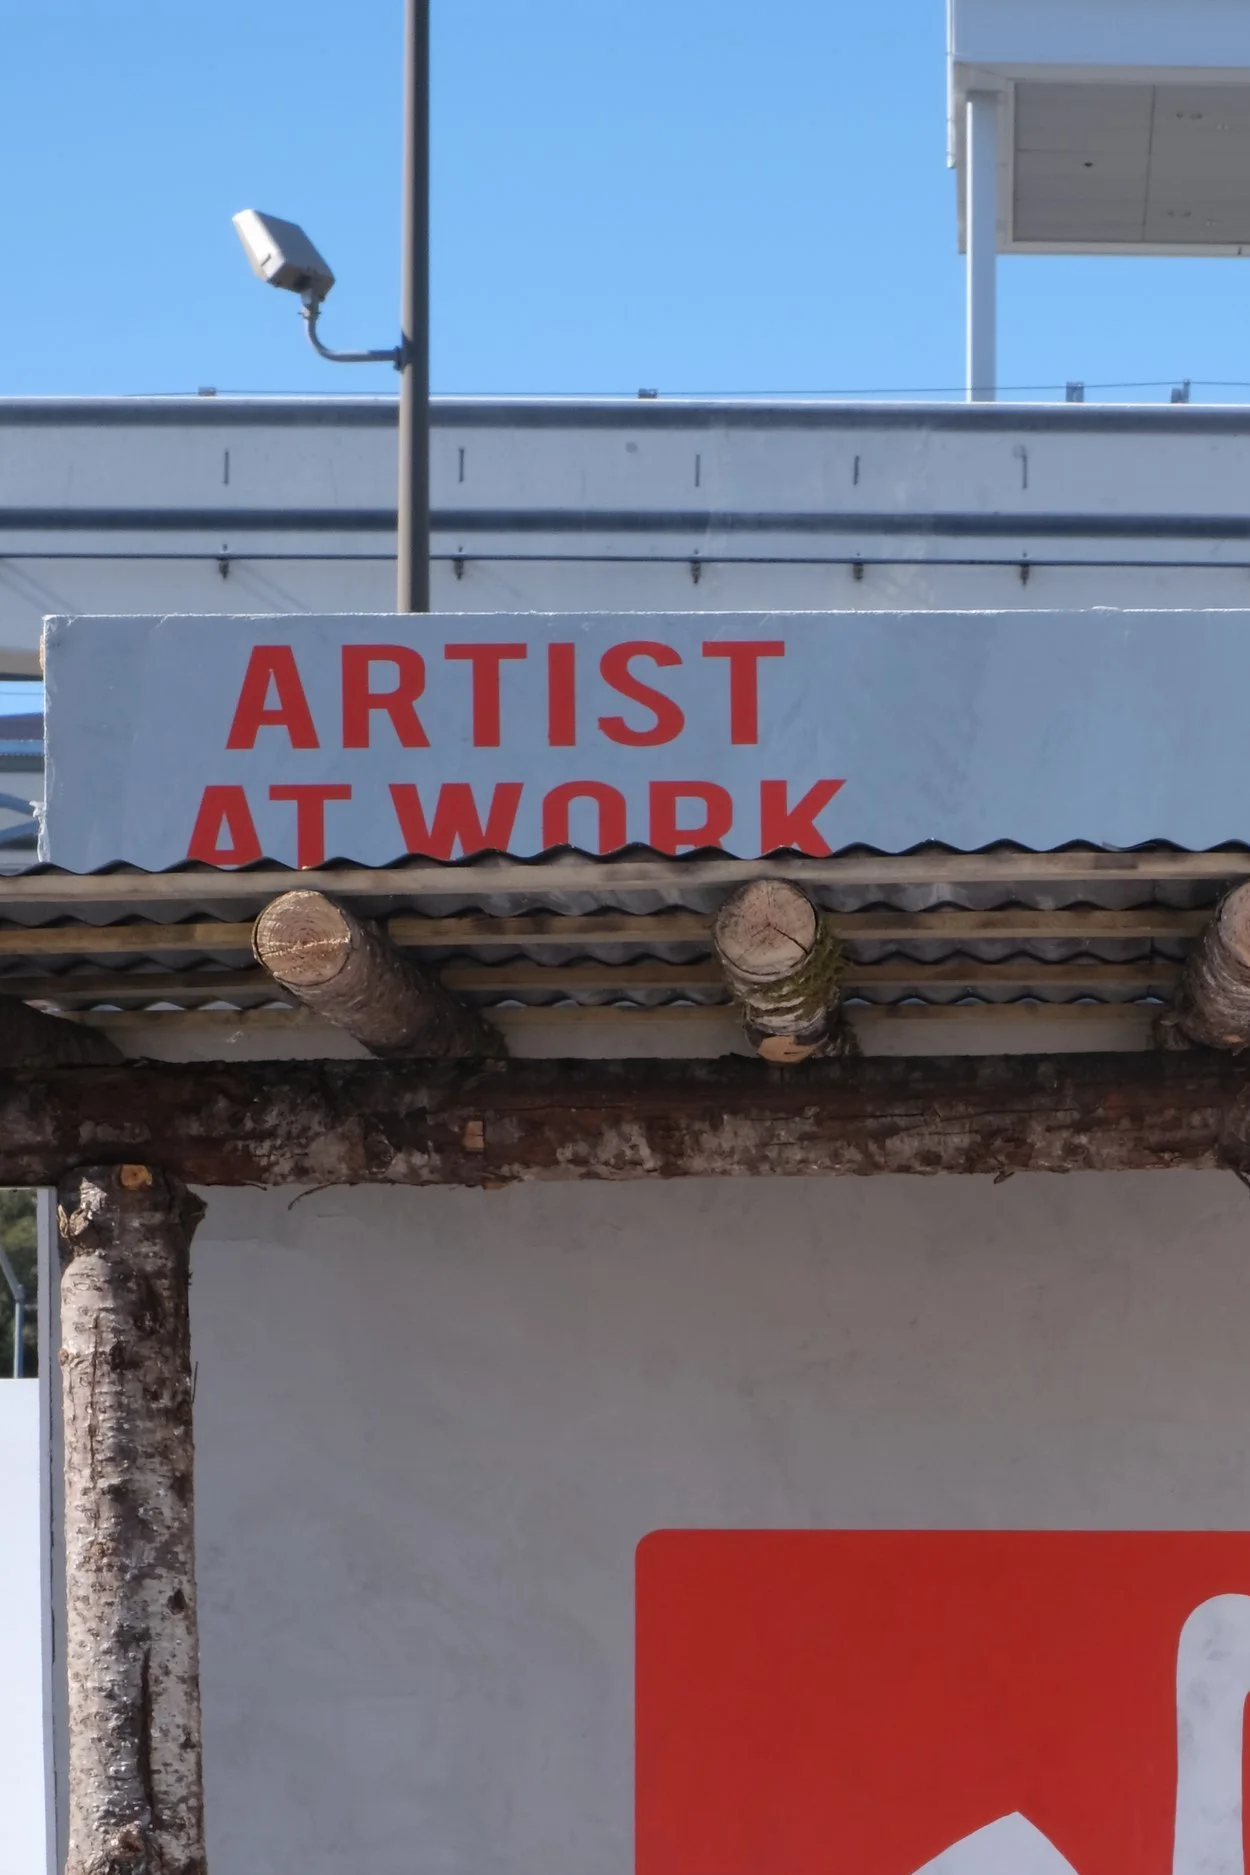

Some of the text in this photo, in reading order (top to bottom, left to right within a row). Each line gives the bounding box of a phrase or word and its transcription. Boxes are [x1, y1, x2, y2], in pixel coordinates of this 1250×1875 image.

[226, 640, 785, 749] ARTIST
[187, 779, 847, 869] AT WORK
